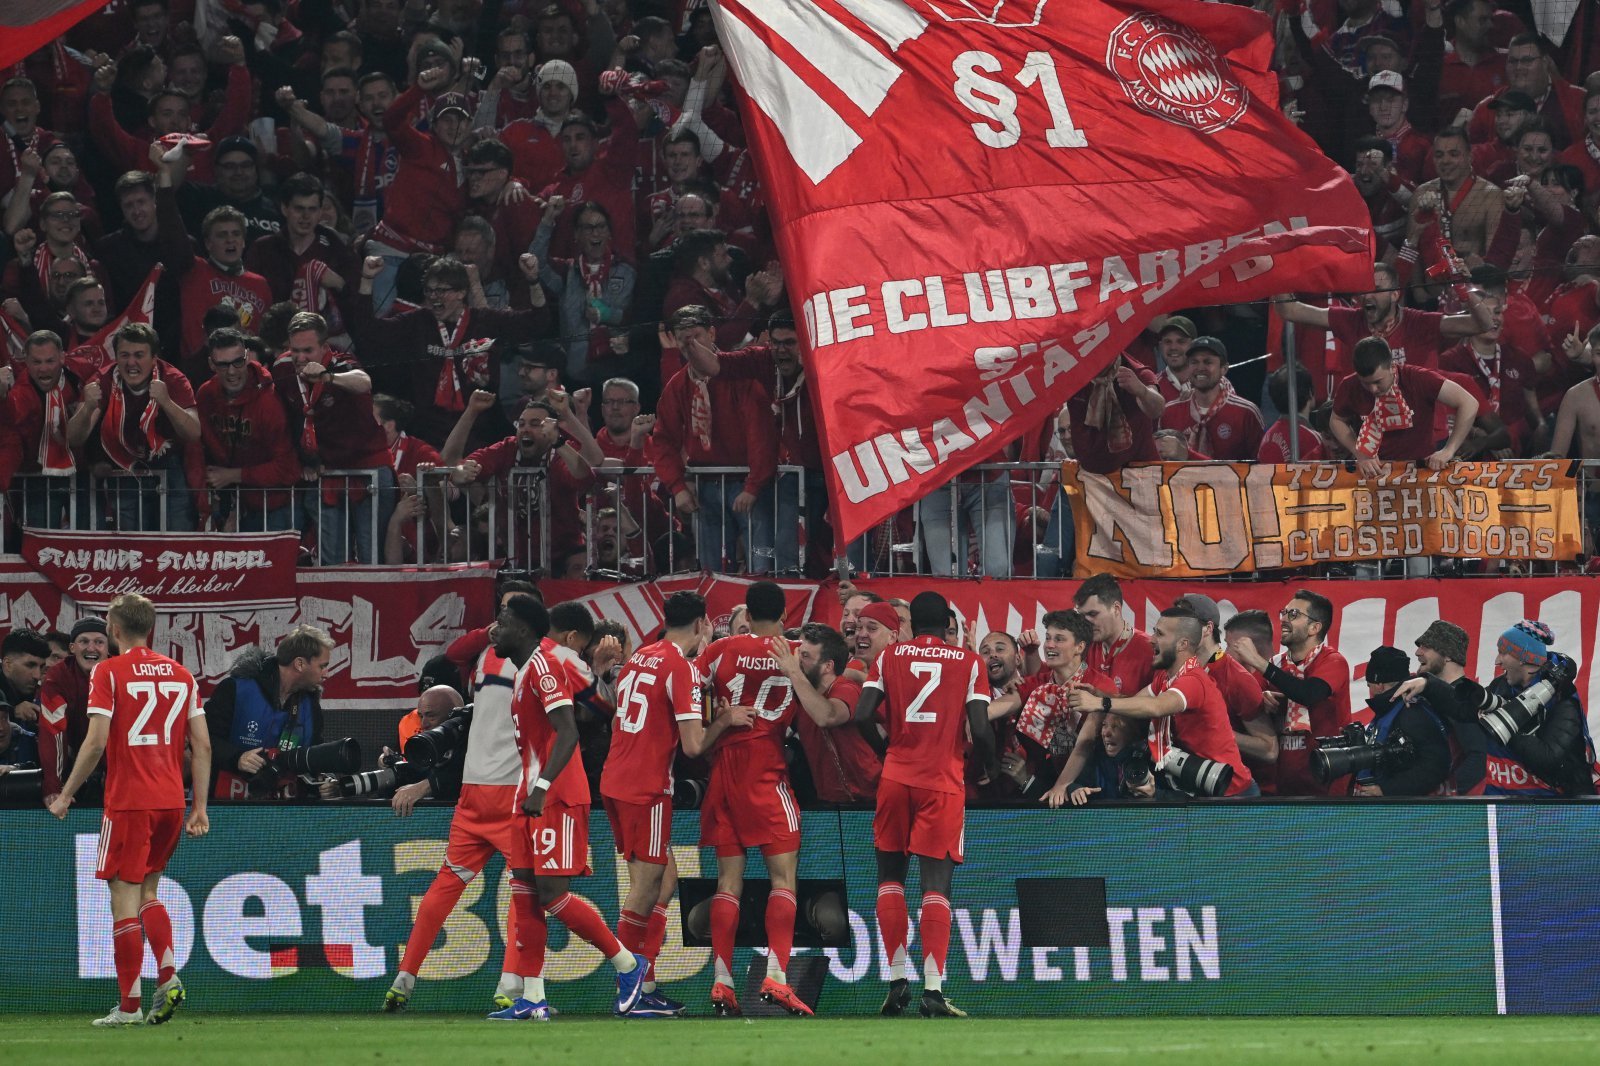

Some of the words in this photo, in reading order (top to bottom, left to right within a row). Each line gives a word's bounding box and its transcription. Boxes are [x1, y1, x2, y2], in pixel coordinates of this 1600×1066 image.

[952, 50, 1089, 149] §1
[1128, 79, 1221, 125] MÜNCHEN
[803, 284, 875, 351] DIE
[1286, 464, 1339, 490] TO
[1077, 463, 1283, 570] NO!
[1354, 488, 1489, 522] BEHIND
[37, 547, 92, 570] STAY
[93, 549, 143, 571] RUDE
[157, 550, 210, 571] STAY
[211, 549, 273, 570] REBEL
[1287, 523, 1424, 562] CLOSED
[1441, 523, 1555, 559] DOORS
[67, 573, 162, 595] Rebellisch
[166, 573, 246, 595] bleiben!
[132, 663, 174, 676] LAIMER
[629, 652, 664, 670] AVLOVIĆ
[894, 644, 965, 660] UPAMECANO
[544, 691, 563, 702] Allianz
[616, 670, 657, 734] 45
[726, 673, 794, 721] 10
[905, 661, 942, 723] 2
[126, 681, 189, 746] 27
[532, 828, 557, 855] 19
